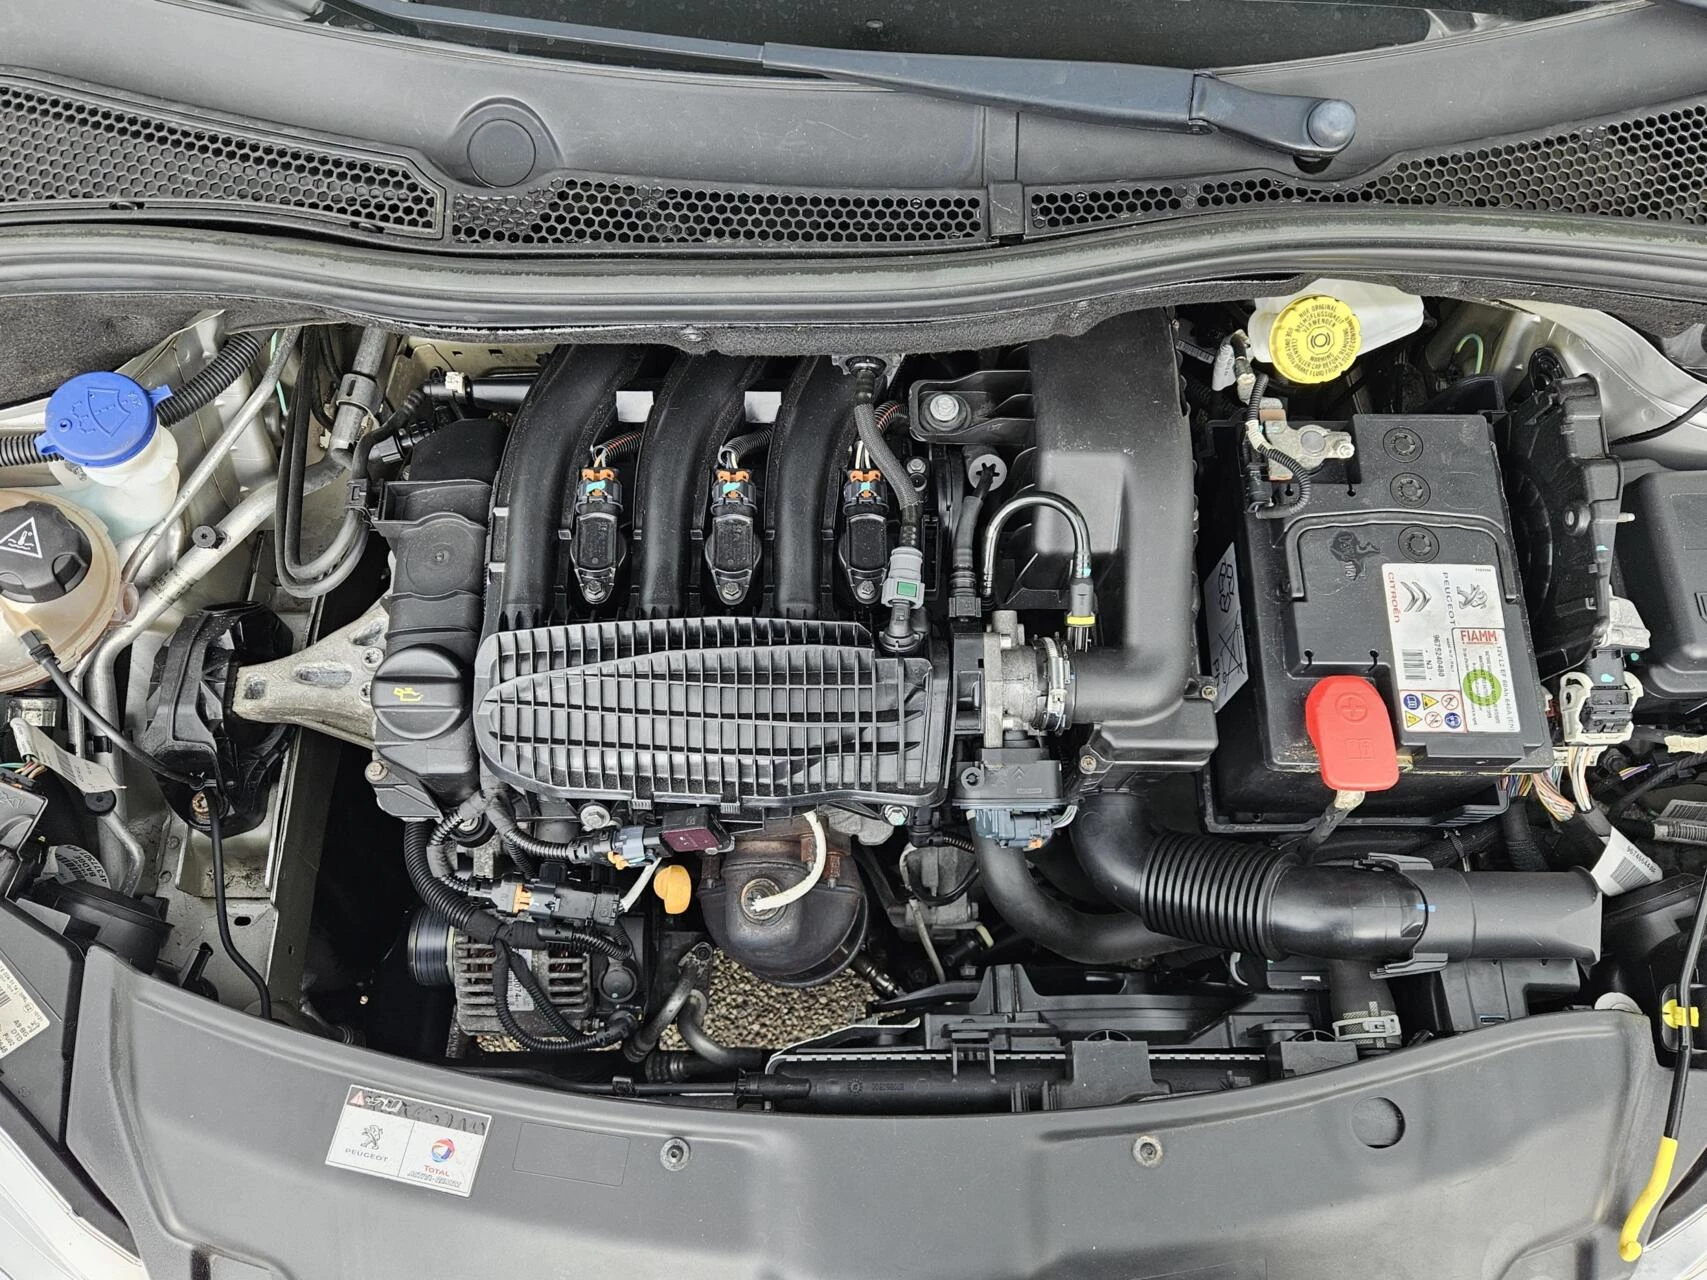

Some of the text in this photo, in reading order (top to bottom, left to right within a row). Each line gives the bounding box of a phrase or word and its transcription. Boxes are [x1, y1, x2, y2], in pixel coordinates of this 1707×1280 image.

[1311, 303, 1337, 312] ORIGINAL
[1302, 318, 1336, 333] VERWENDEN
[1297, 354, 1310, 367] FILLER
[1322, 355, 1341, 368] BEFORE
[1310, 352, 1335, 362] WARNING
[1325, 365, 1339, 376] FROM
[1442, 572, 1456, 626] PEUGEOT
[1460, 630, 1498, 642] FIAMM
[345, 1148, 388, 1162] PEUGEOT
